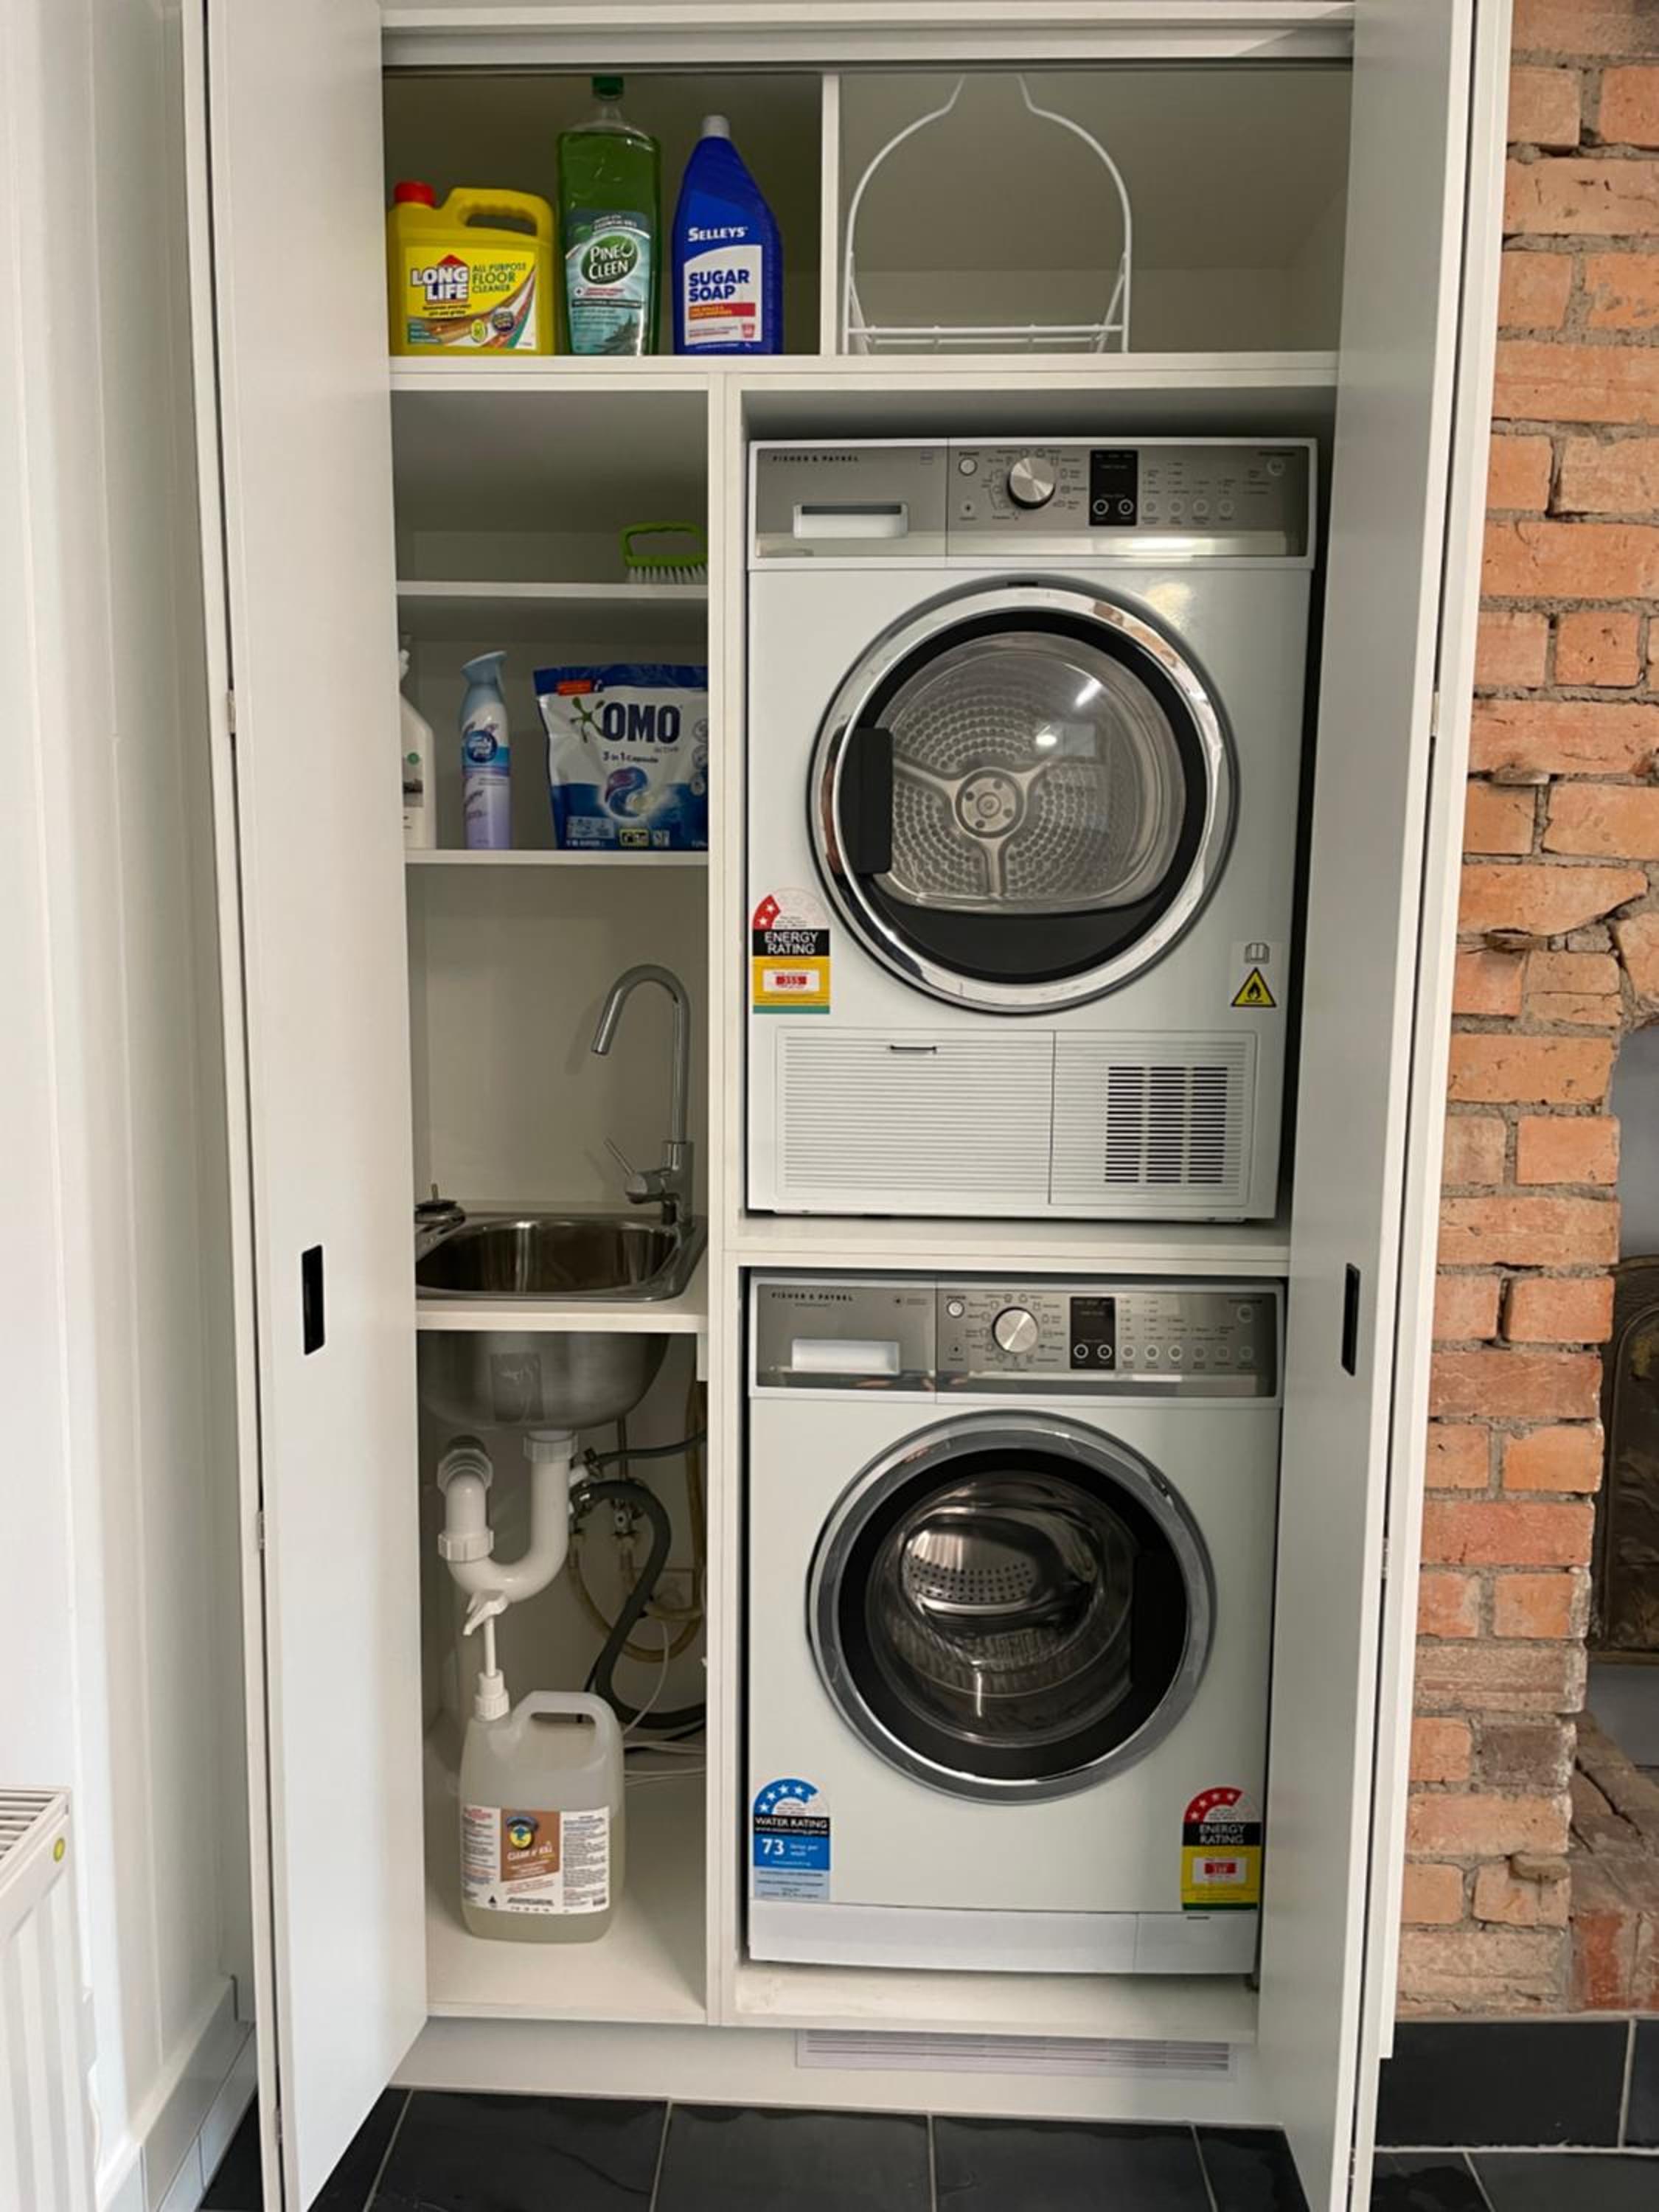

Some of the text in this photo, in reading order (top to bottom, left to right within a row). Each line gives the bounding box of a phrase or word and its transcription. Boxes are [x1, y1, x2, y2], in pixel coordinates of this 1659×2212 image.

[688, 226, 745, 242] SELLEYS
[473, 262, 526, 272] ALL PURPOSE
[588, 260, 628, 279] CLEEN
[411, 266, 469, 286] LONG
[473, 272, 515, 284] FLOOR
[689, 269, 750, 287] SUGAR
[425, 283, 469, 301] LIFE
[473, 284, 510, 293] CLEANER
[689, 285, 736, 302] SOAP
[603, 702, 681, 744] OMO
[764, 931, 818, 943] ENERGY
[767, 943, 815, 954] RATING
[755, 1817, 828, 1829] WATER RATING
[1199, 1824, 1245, 1834] ENERGY
[1200, 1834, 1245, 1844] RATING
[762, 1838, 785, 1855] 73
